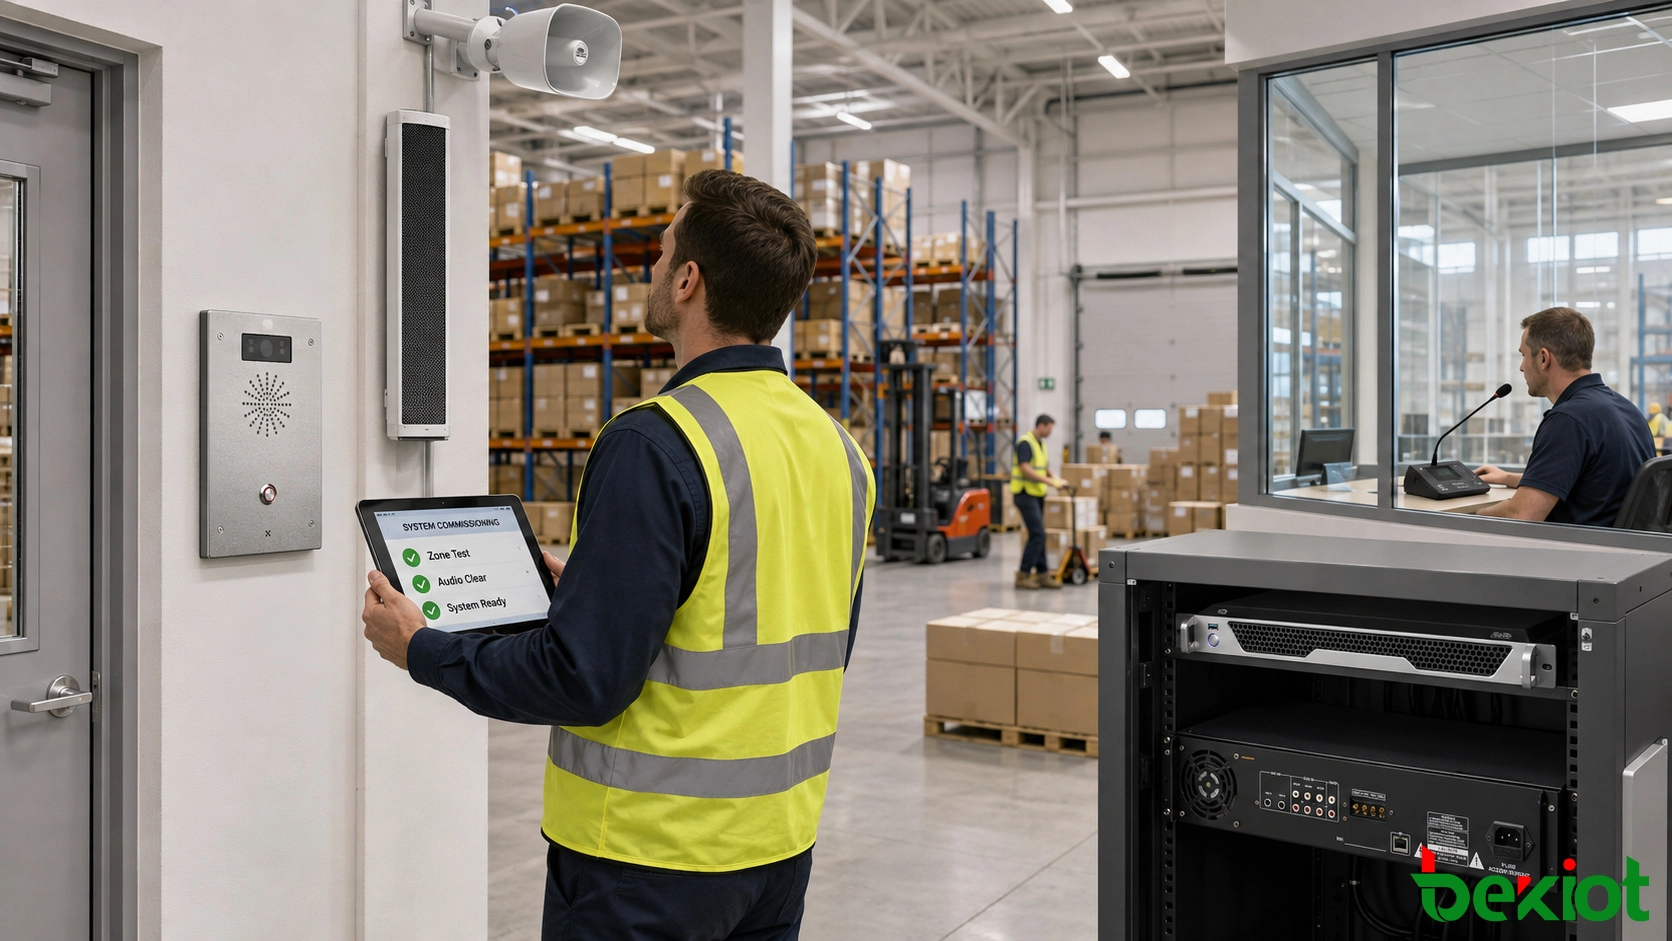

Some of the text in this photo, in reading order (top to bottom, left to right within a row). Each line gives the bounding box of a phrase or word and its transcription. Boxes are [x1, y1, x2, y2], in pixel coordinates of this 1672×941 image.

[402, 518, 500, 532] SYSTEM COMMISSIONING
[426, 549, 471, 561] Zone Test
[438, 573, 487, 587] Audio Clear
[446, 597, 507, 614] System Ready
